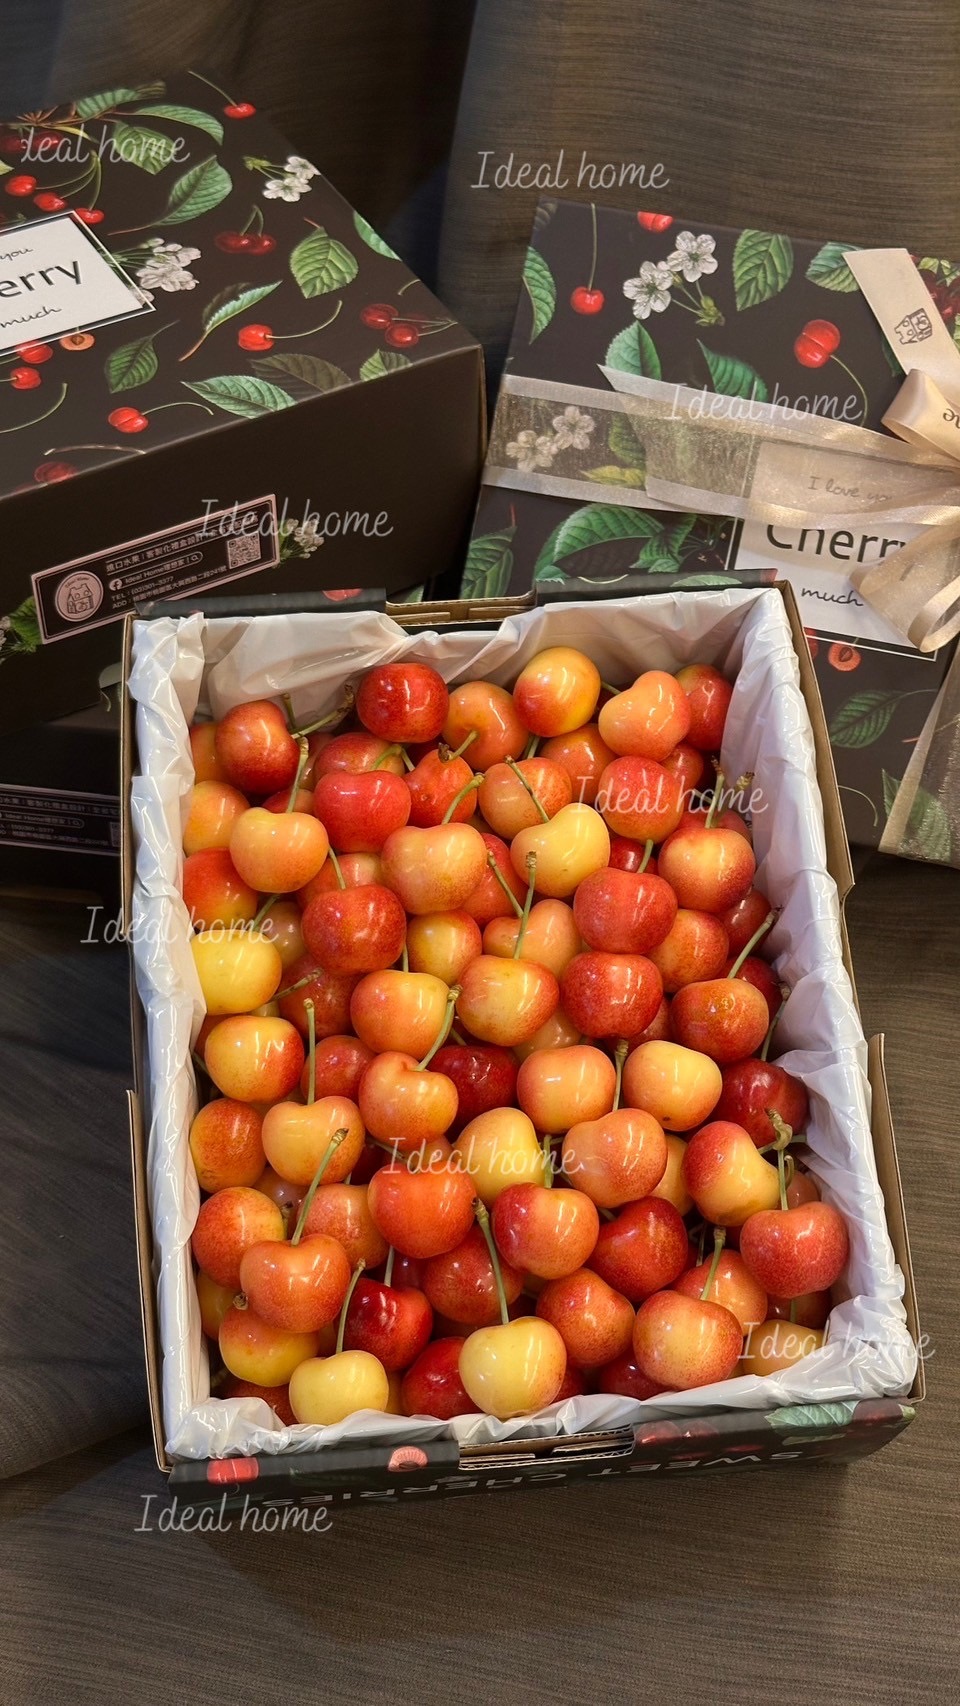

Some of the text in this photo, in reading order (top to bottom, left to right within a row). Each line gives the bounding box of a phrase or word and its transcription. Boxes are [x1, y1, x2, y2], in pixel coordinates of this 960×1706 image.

[0, 306, 62, 328] much
[826, 477, 861, 498] love
[801, 586, 864, 607] much
[262, 1451, 803, 1507] SWEET CHERRIES
